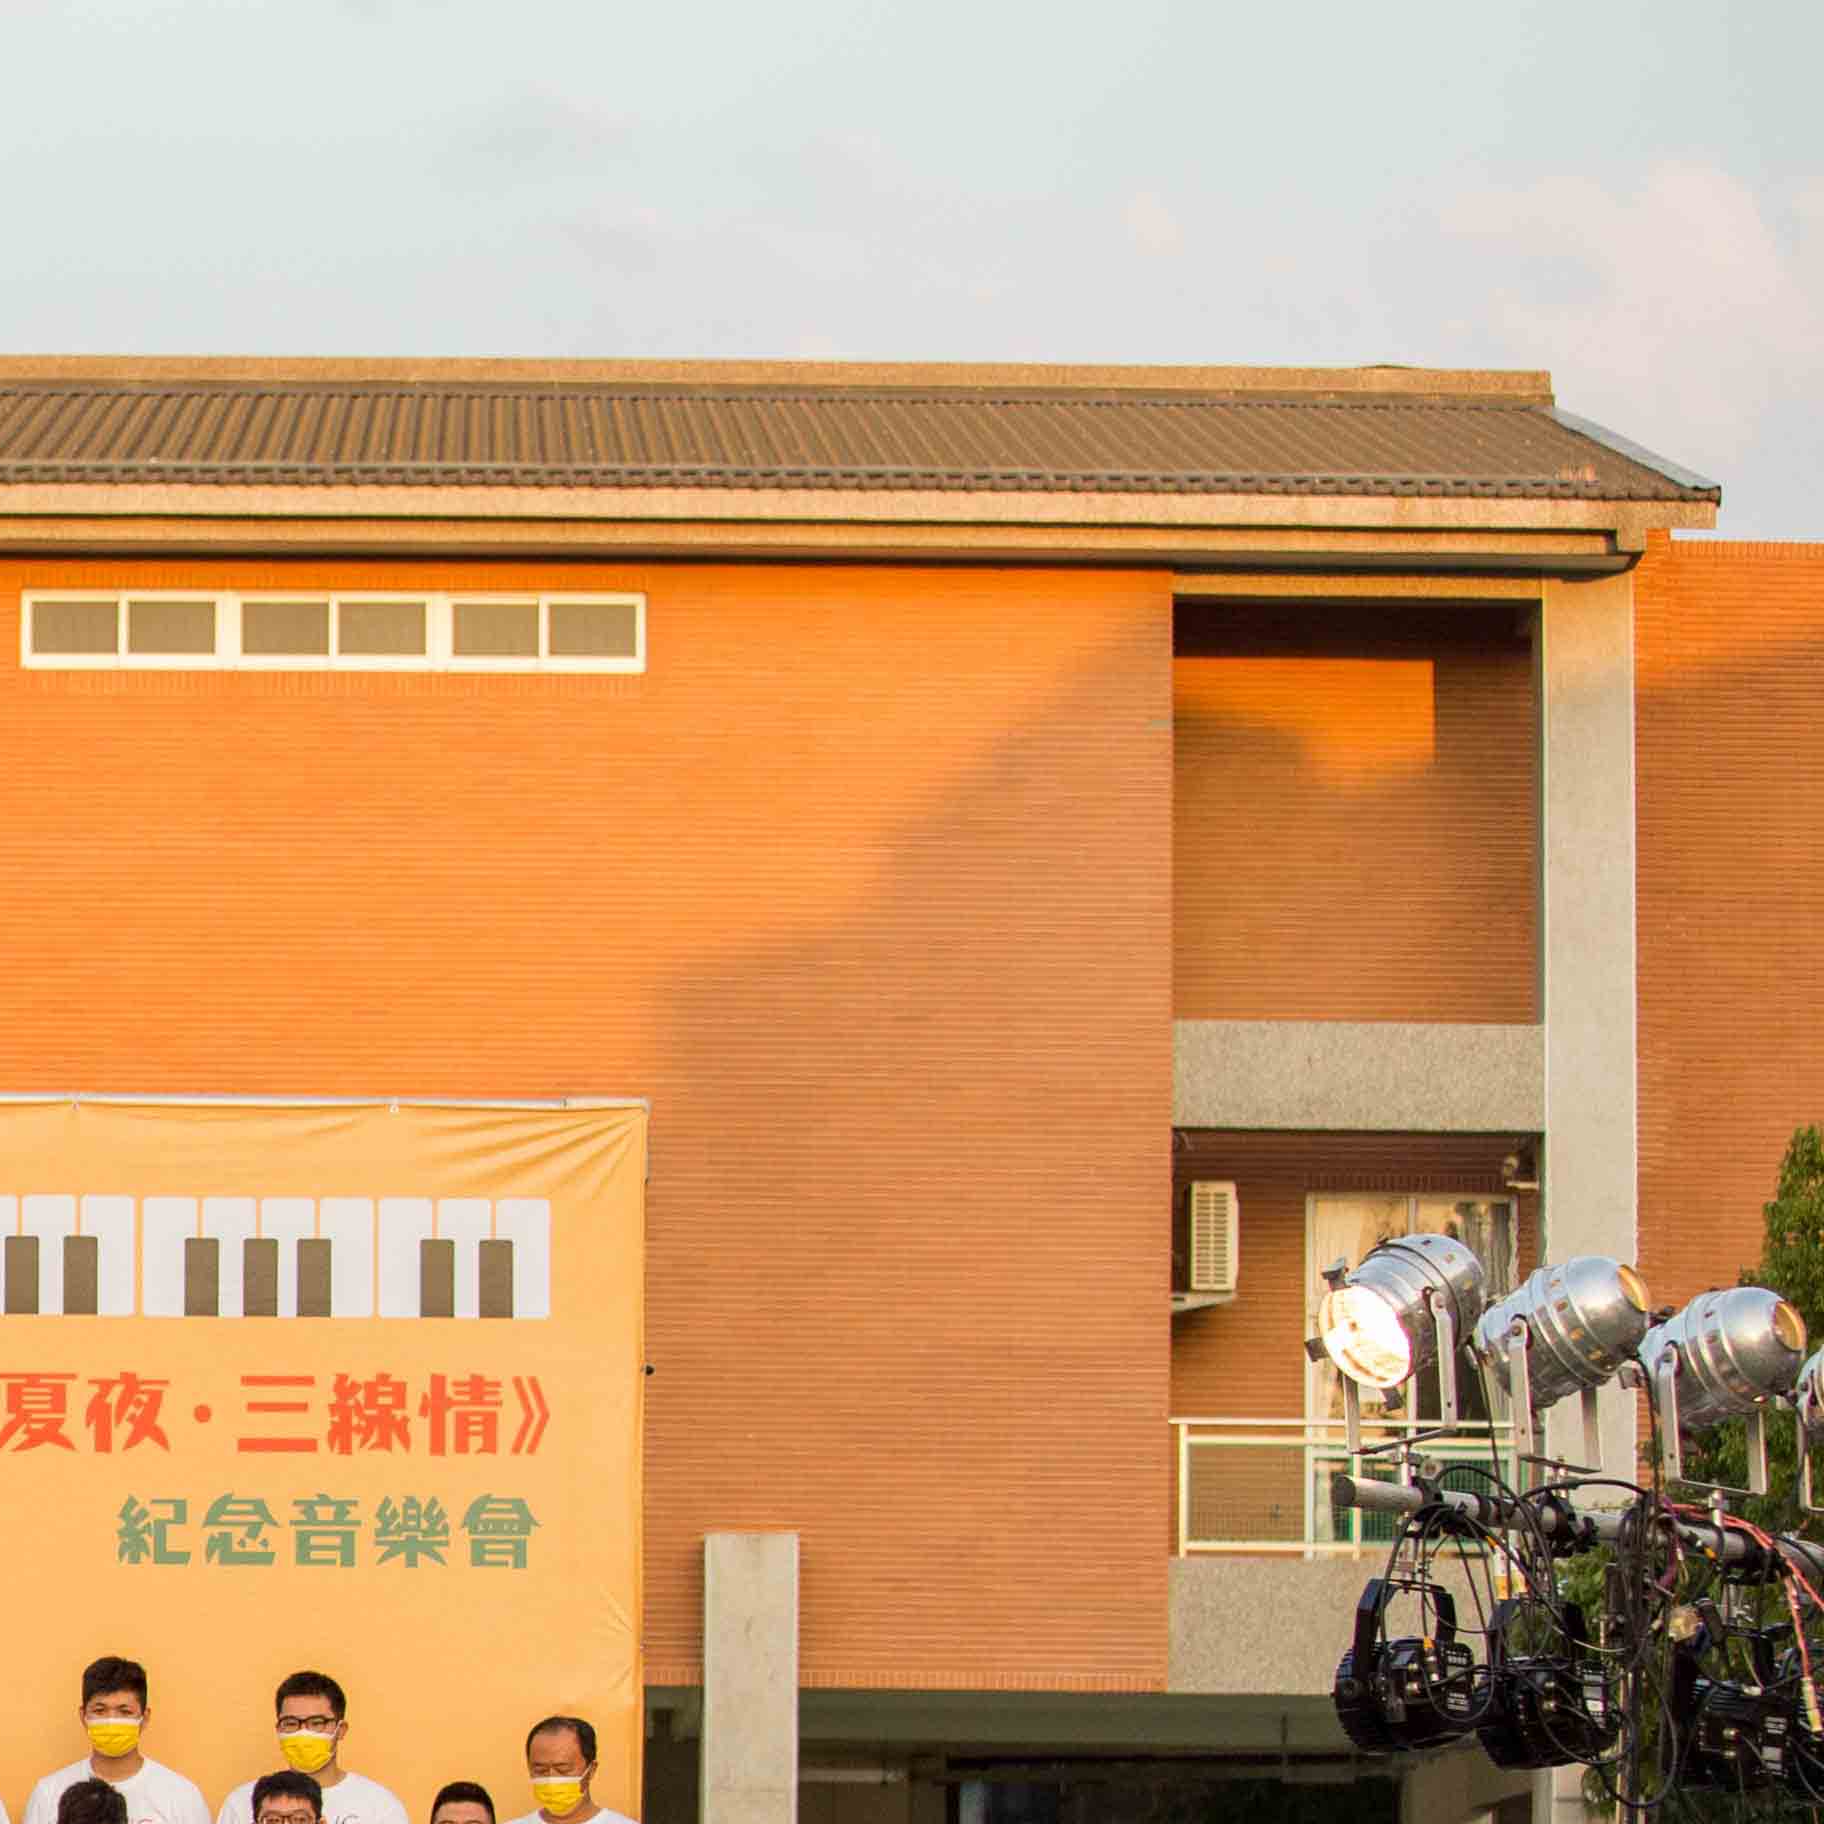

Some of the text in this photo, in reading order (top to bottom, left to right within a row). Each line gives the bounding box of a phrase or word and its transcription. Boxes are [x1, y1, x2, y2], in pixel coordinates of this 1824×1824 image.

[115, 1492, 542, 1569] 紀念音樂會
